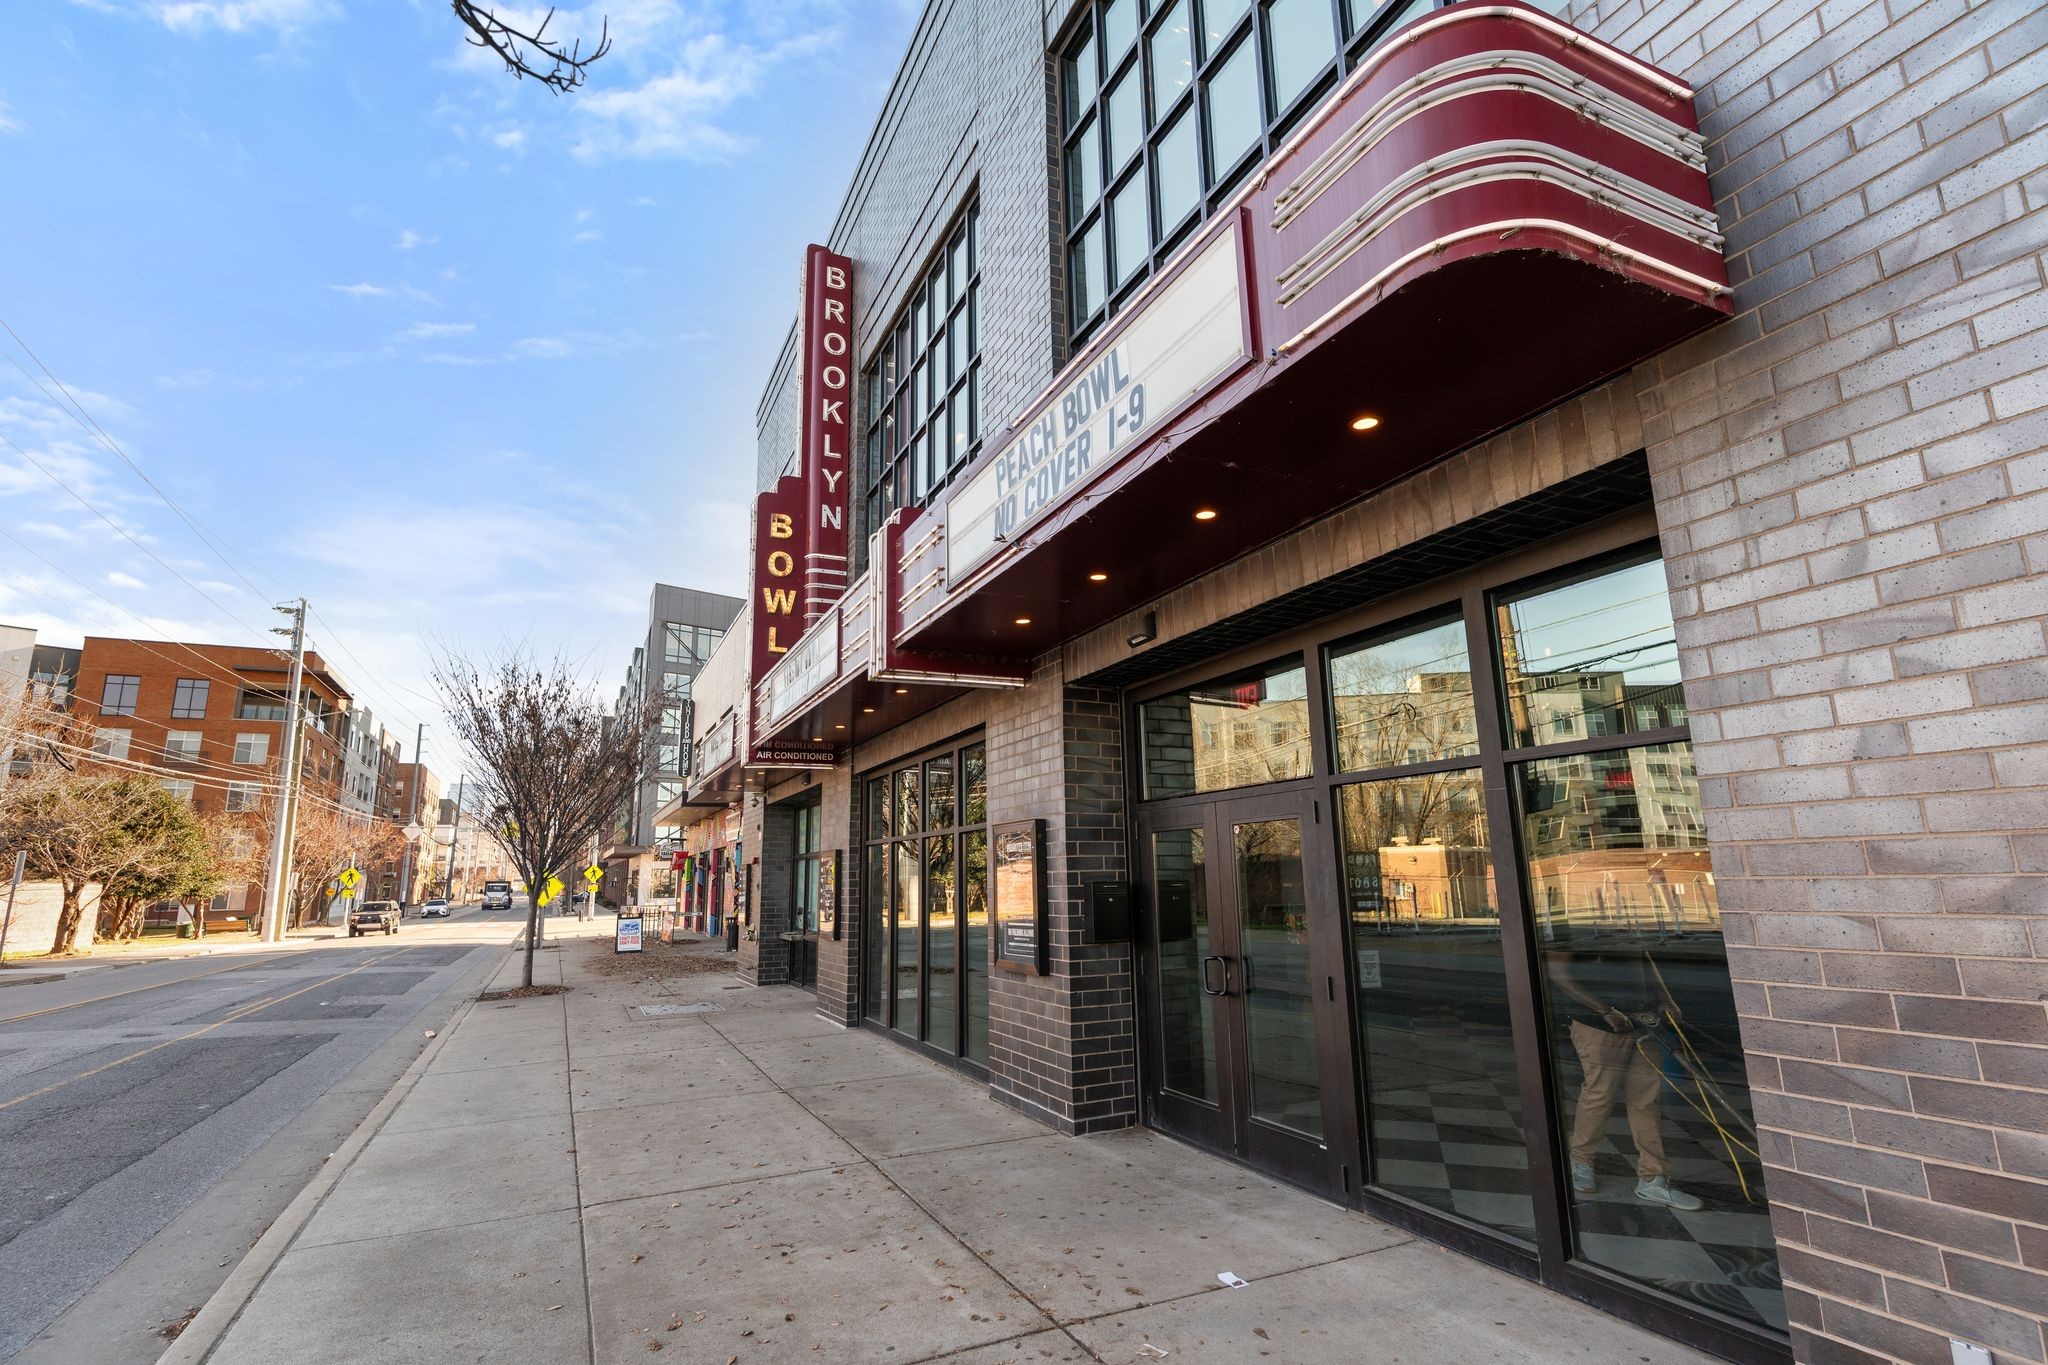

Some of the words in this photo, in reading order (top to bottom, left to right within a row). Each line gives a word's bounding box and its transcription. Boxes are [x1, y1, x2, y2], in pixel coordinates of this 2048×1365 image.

[821, 266, 847, 530] BROOKLYN
[994, 410, 1057, 498] PEACH
[1062, 347, 1130, 439] BOWL
[994, 493, 1017, 537] NO
[1024, 429, 1091, 518] COVER
[763, 512, 797, 654] BOWL
[756, 751, 772, 759] AIR
[774, 752, 835, 761] CONDITIONED
